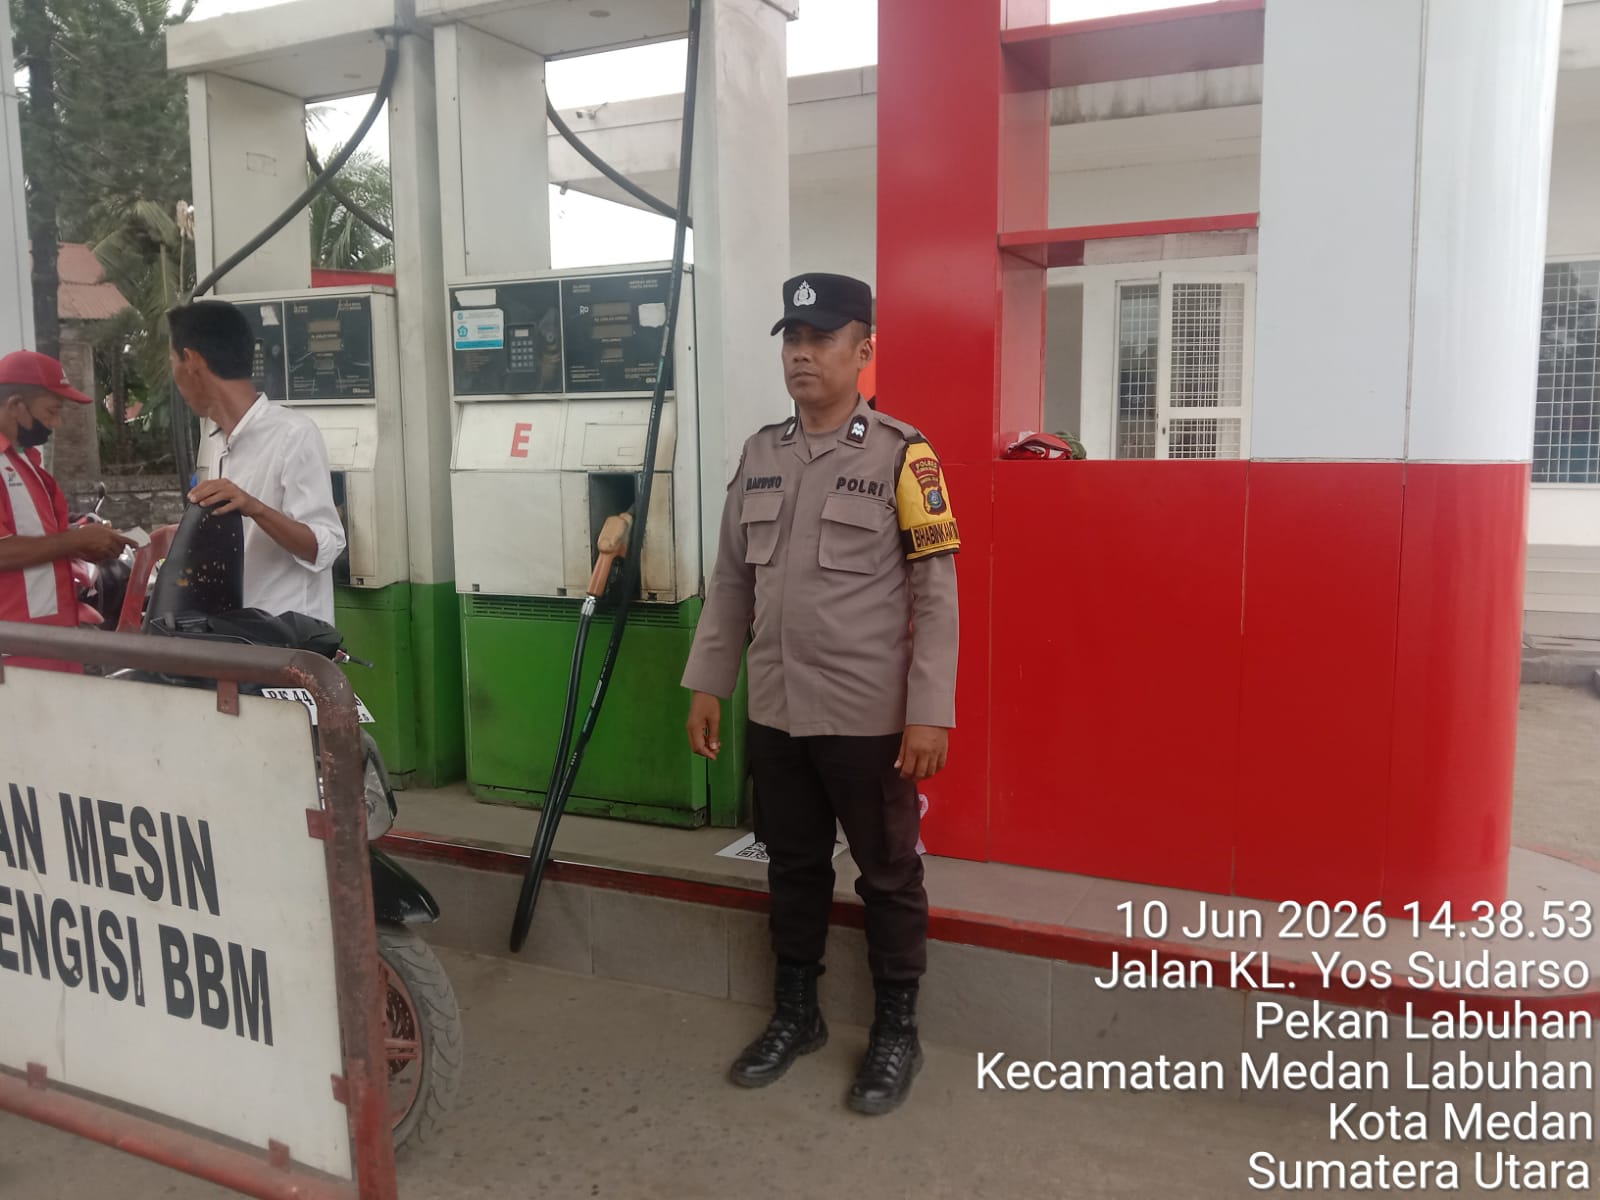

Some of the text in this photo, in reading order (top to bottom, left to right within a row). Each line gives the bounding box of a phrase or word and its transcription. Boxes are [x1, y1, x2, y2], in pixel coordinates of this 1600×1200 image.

[510, 422, 533, 458] E
[836, 476, 885, 496] POLRI
[58, 792, 220, 916] MESIN
[0, 885, 273, 1047] ENGISI BBM
